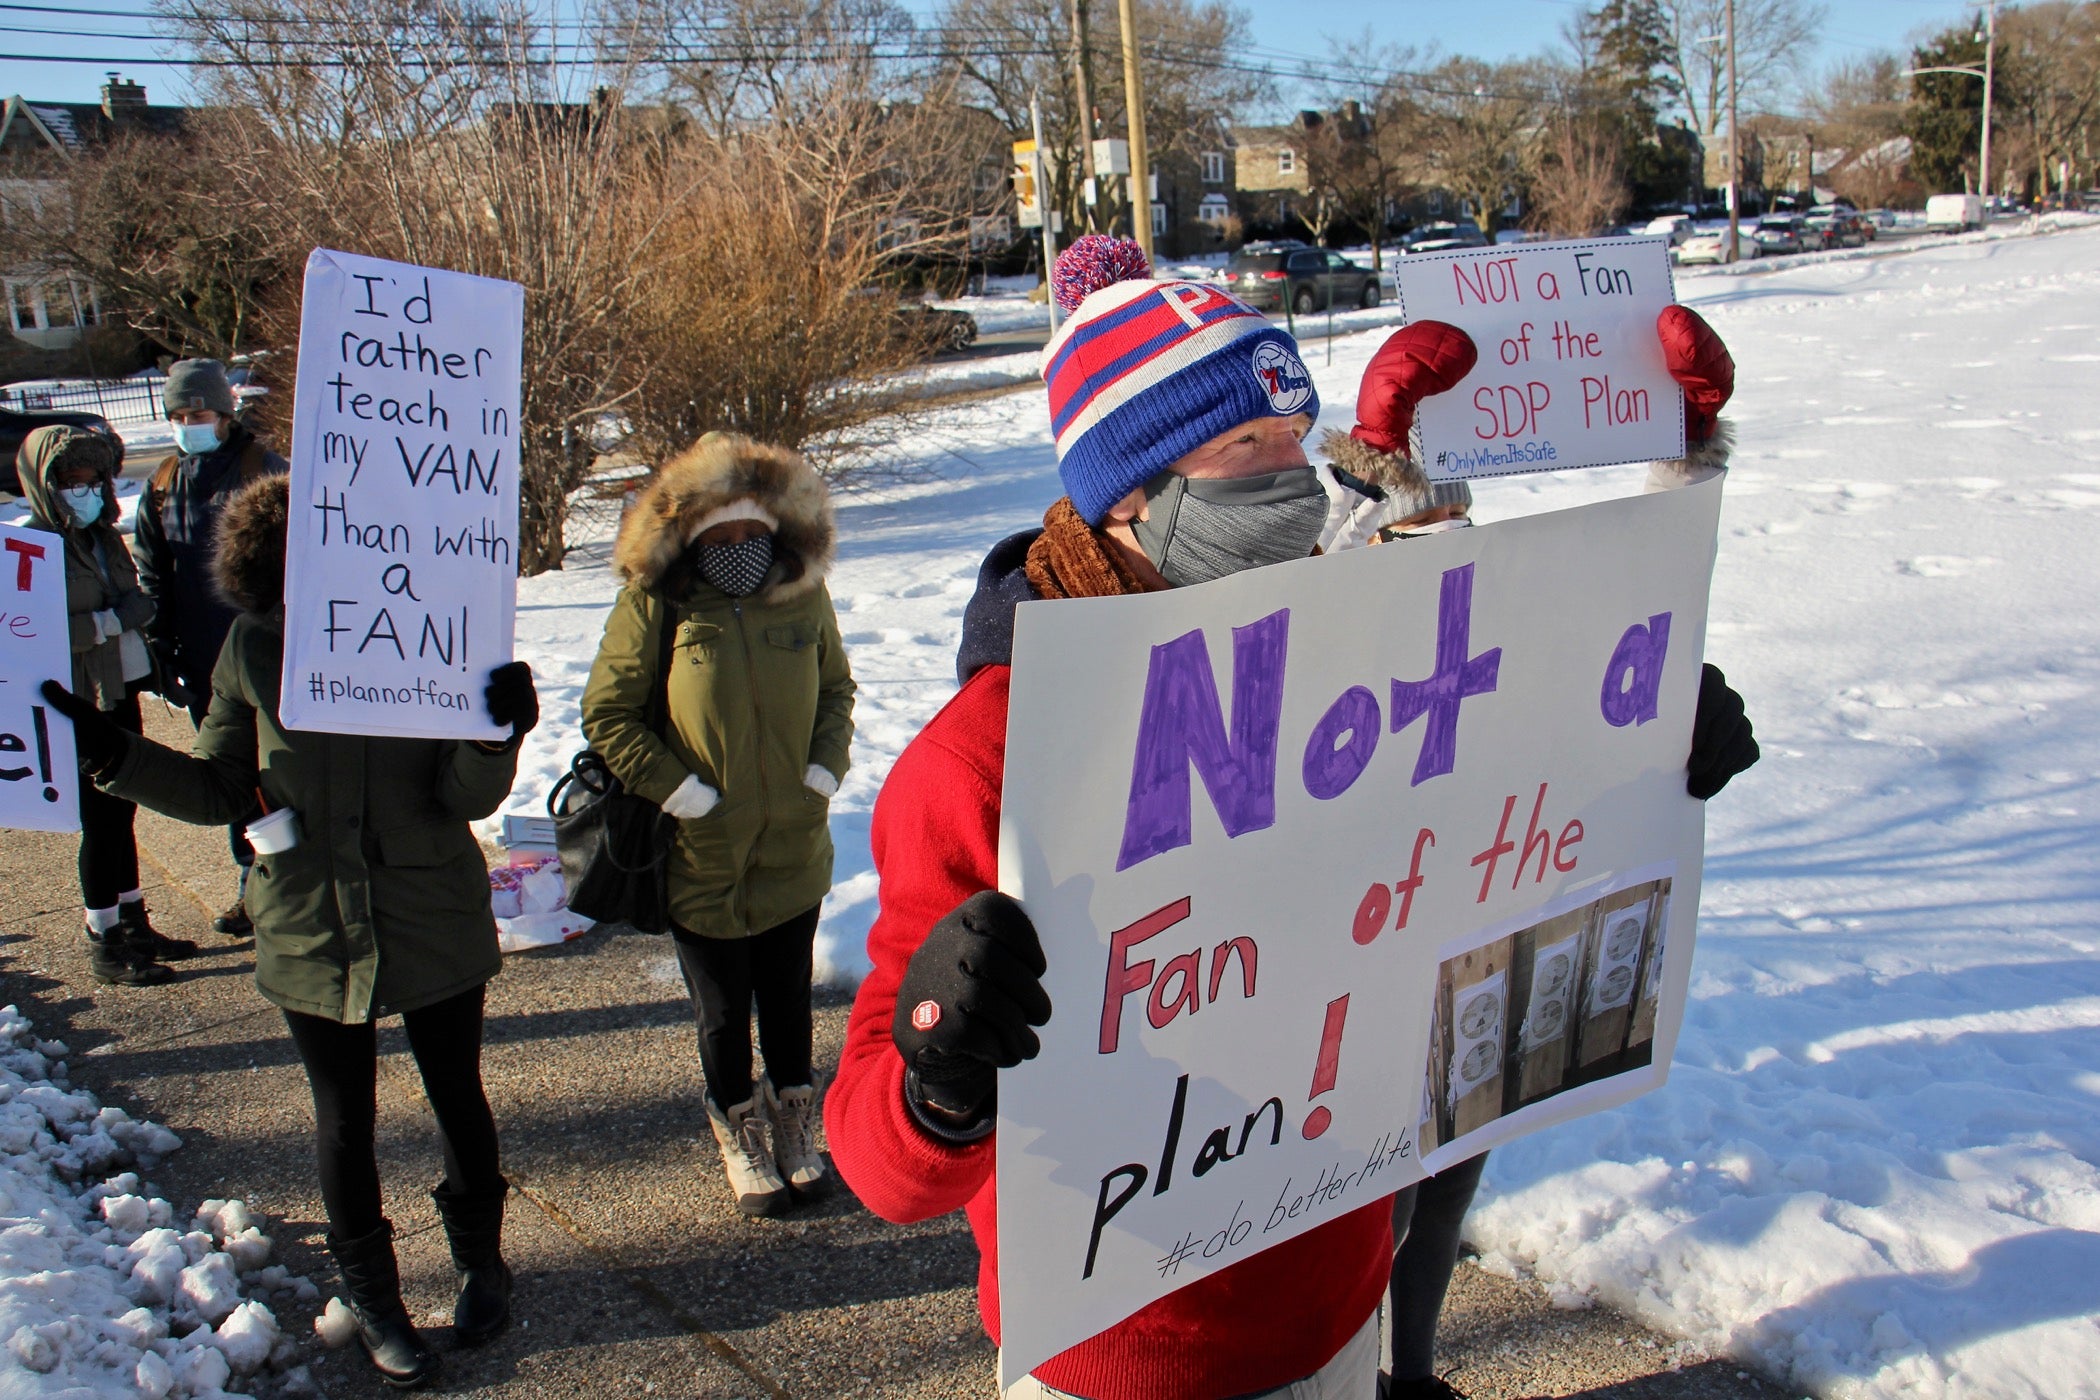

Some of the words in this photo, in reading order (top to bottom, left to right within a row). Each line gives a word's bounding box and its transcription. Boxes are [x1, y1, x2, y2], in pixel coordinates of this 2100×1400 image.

[353, 274, 432, 324] I'd
[1452, 257, 1519, 305] NOT
[1537, 272, 1560, 300] a
[1574, 253, 1633, 296] Fan
[341, 331, 492, 379] rather
[1500, 322, 1534, 365] of
[1552, 320, 1602, 360] the
[327, 372, 448, 432] teach
[482, 399, 508, 437] in
[1474, 381, 1551, 439] SDP
[1580, 375, 1649, 429] Plan
[323, 431, 368, 487] my
[314, 486, 410, 553] than
[435, 516, 509, 565] with
[382, 563, 421, 601] a
[323, 600, 467, 672] FAN!
[308, 672, 470, 711] #plannotfan
[1115, 561, 1502, 873] Not
[1600, 611, 1672, 727] a
[1098, 896, 1257, 1055] Fan
[1352, 827, 1435, 946] of
[1470, 782, 1585, 903] the
